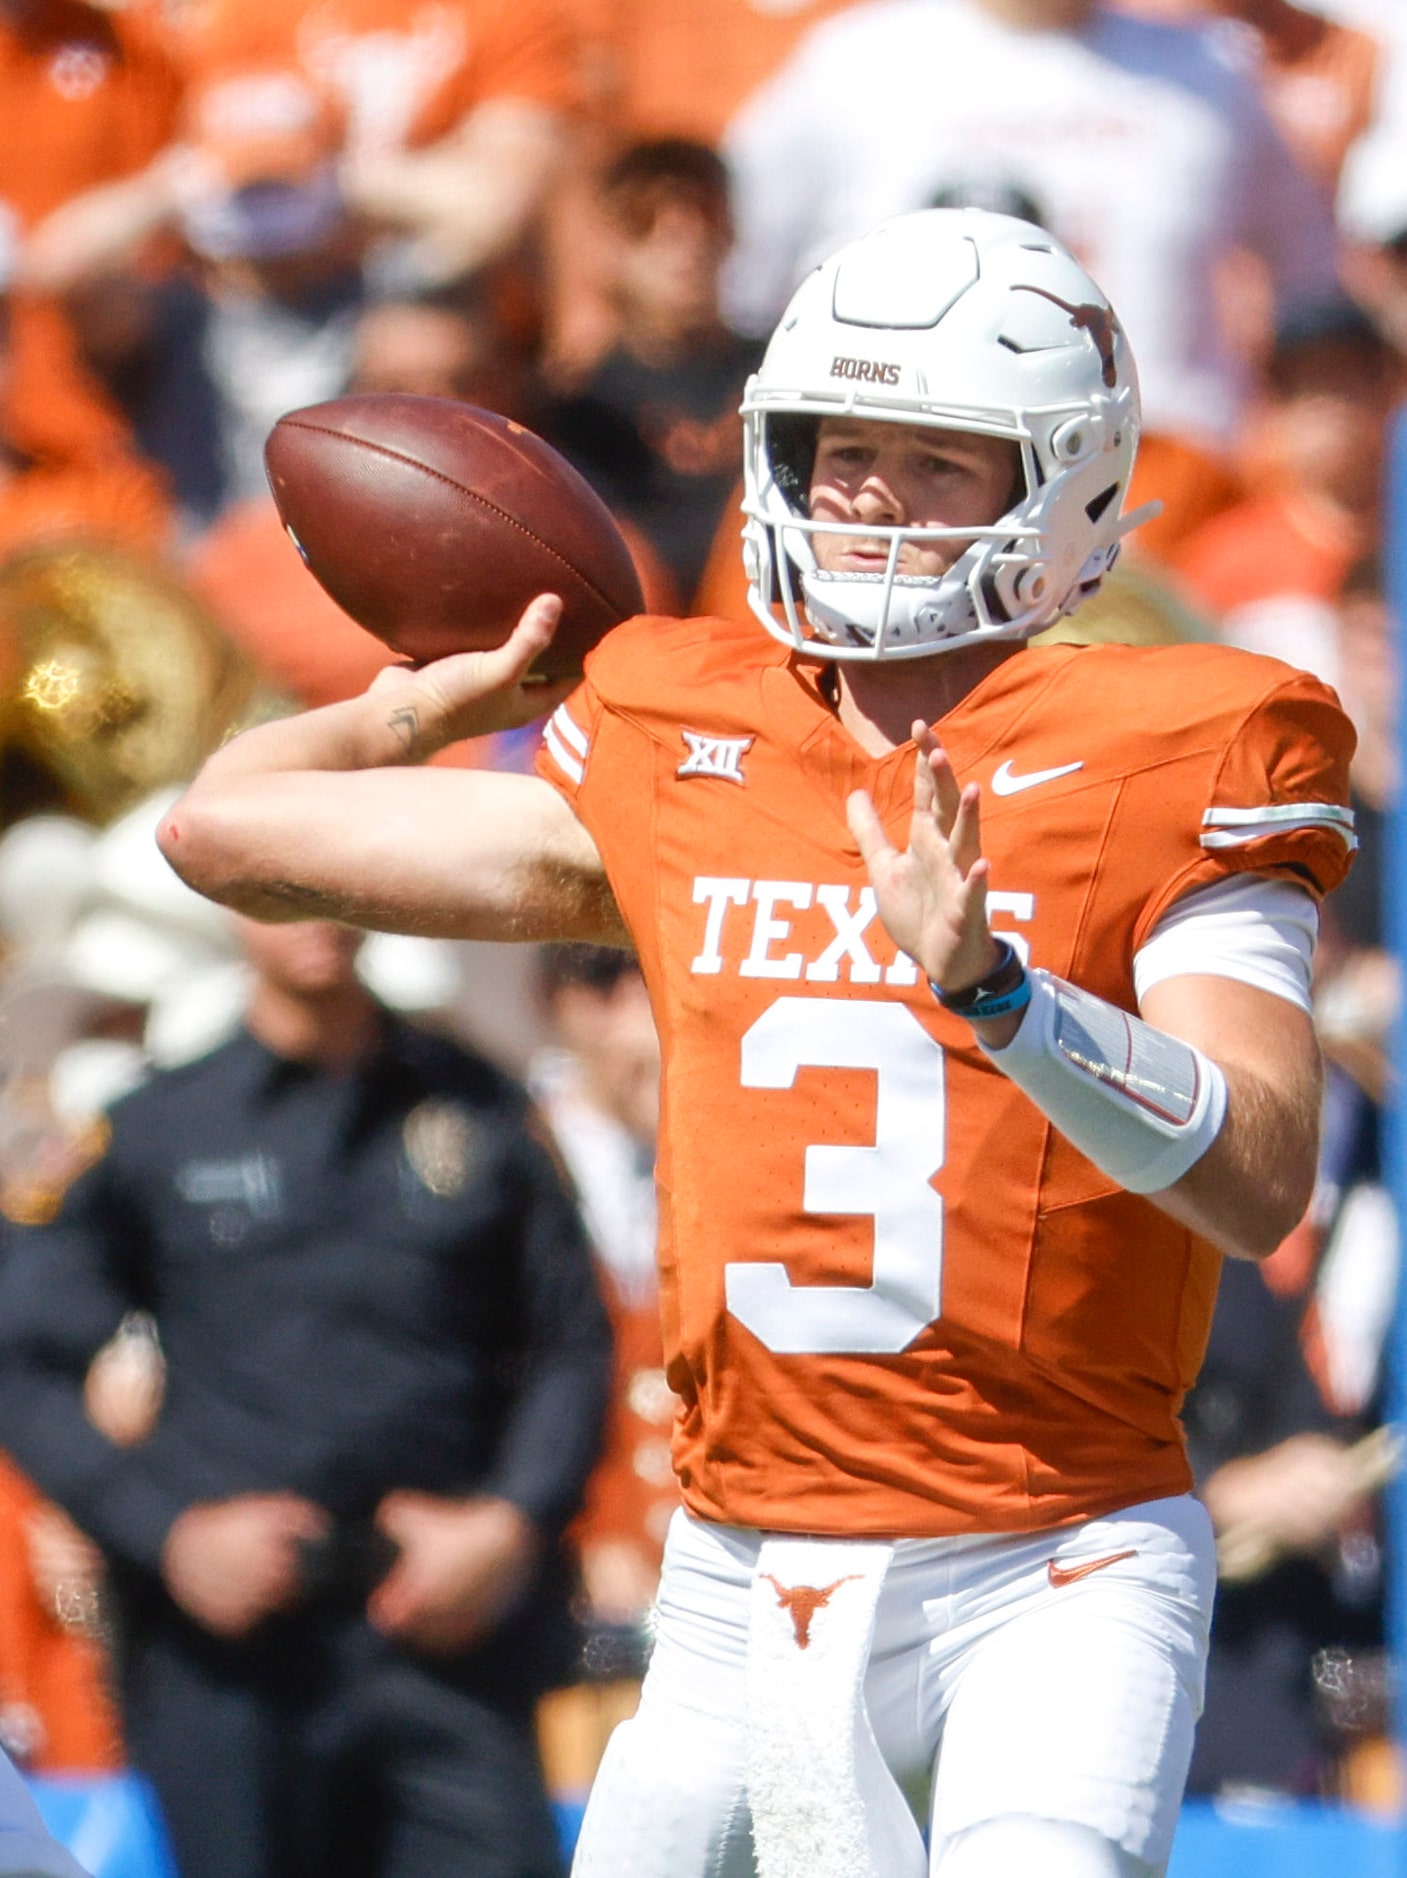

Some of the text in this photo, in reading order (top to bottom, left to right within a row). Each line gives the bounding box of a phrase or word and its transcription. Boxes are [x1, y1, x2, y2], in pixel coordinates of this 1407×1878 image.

[830, 356, 901, 385] HORNS
[676, 729, 755, 784] XII
[691, 876, 1034, 984] TEXS
[724, 996, 946, 1353] 3
